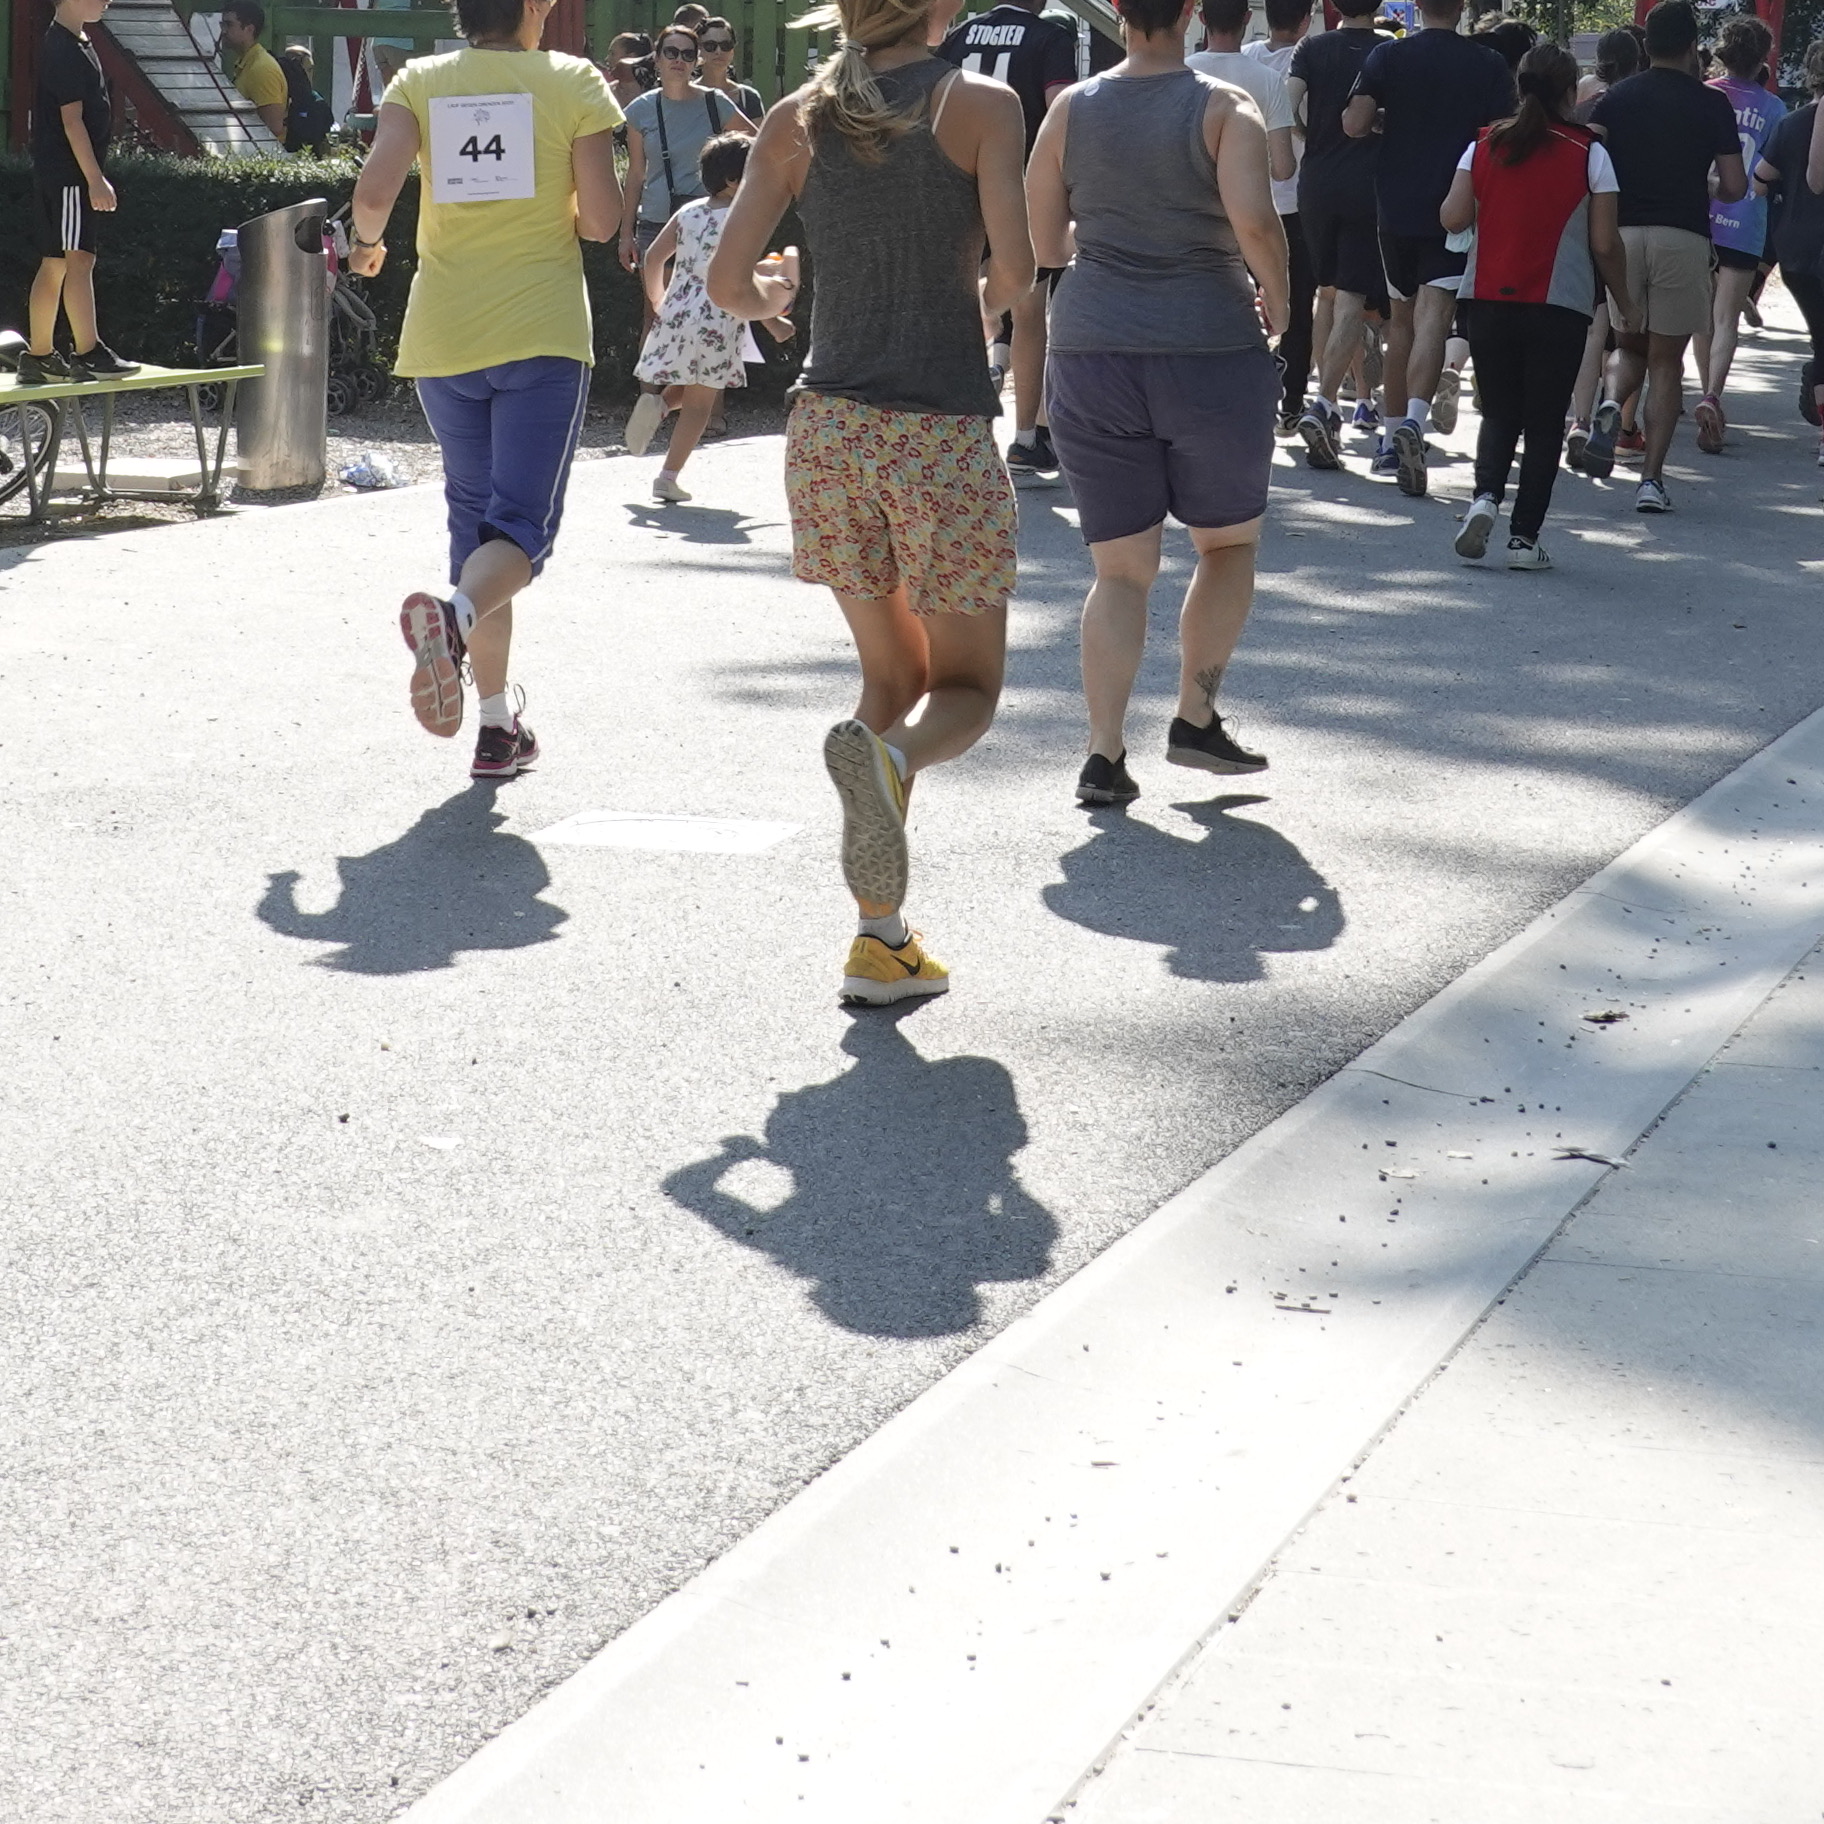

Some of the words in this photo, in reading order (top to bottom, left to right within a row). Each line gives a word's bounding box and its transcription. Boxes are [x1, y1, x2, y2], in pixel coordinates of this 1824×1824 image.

[965, 24, 1026, 46] STOCKER
[459, 134, 506, 162] 44
[1715, 214, 1741, 229] Bern
